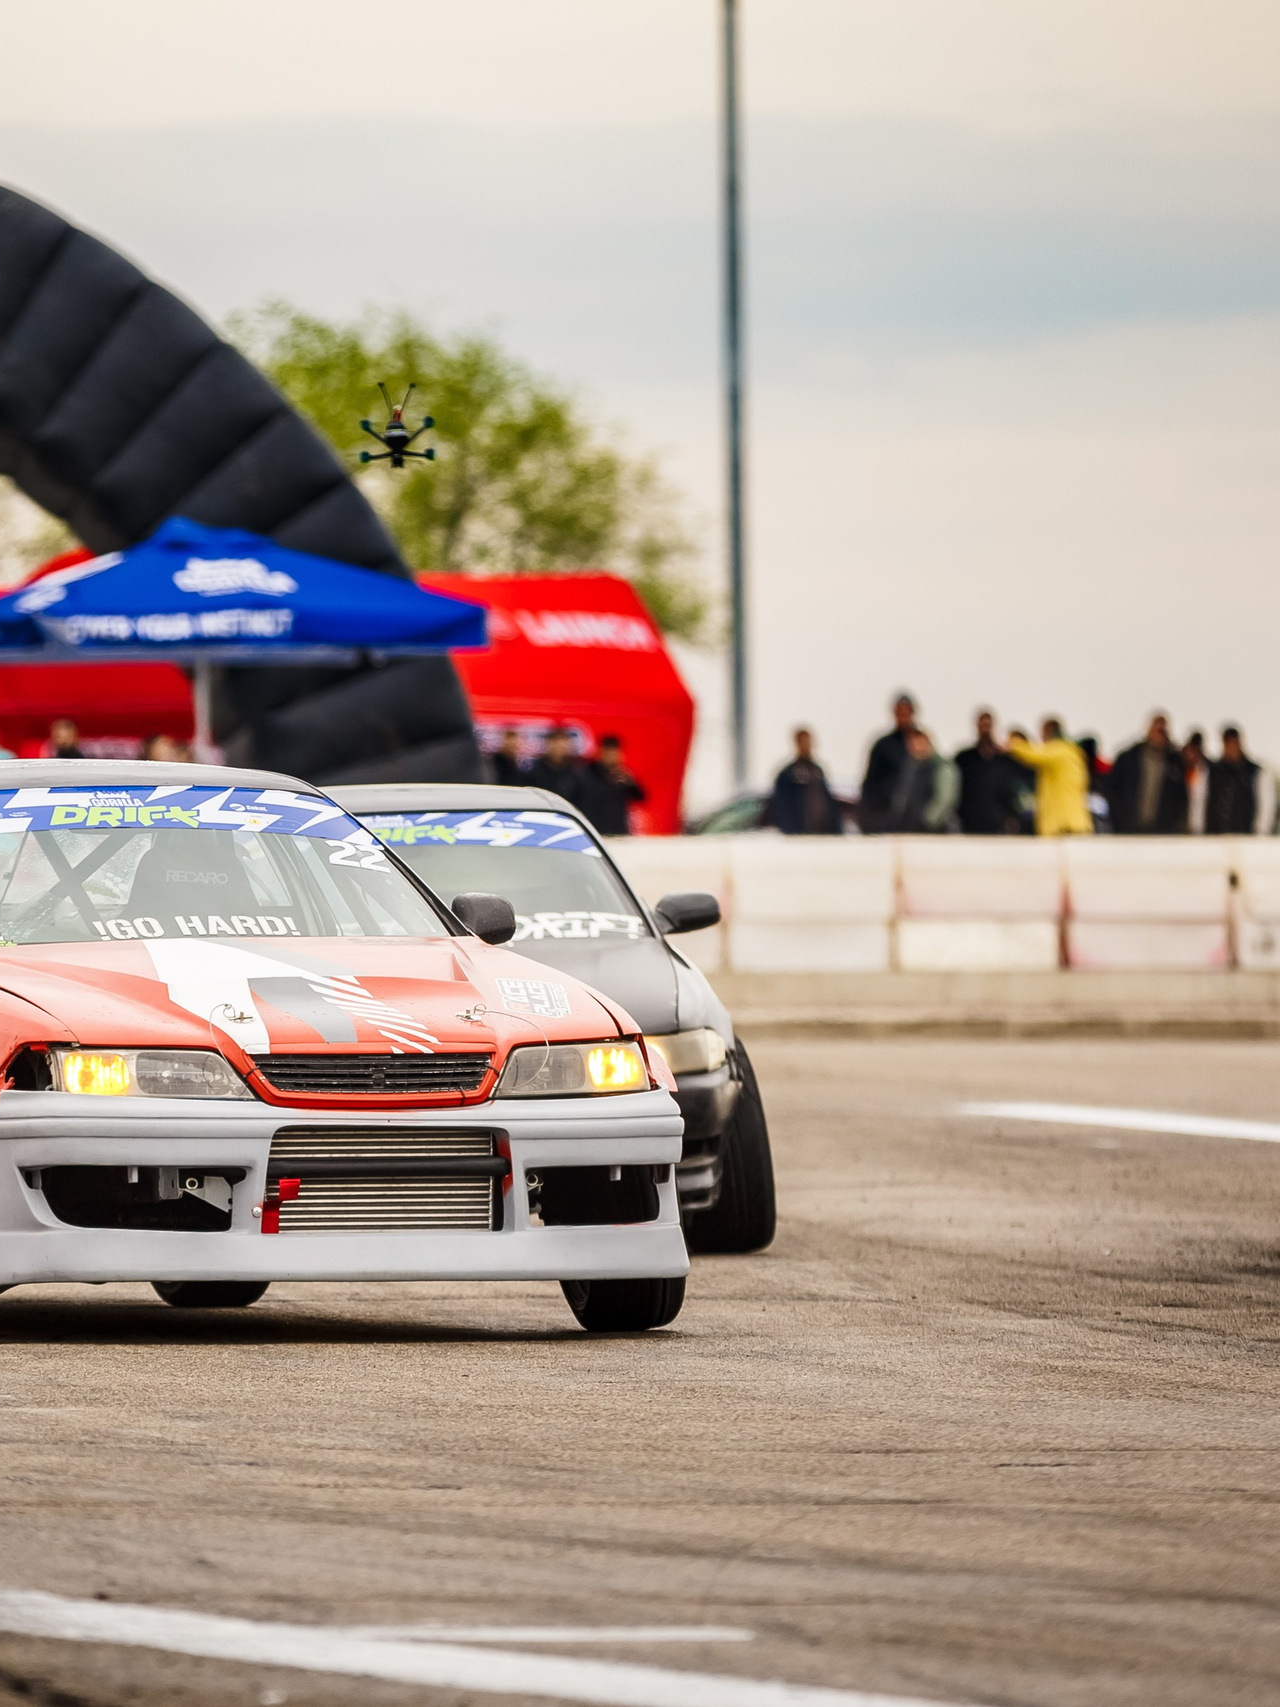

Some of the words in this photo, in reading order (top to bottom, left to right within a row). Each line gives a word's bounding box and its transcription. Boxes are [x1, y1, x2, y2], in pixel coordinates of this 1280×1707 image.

[89, 796, 145, 807] GORILLA
[50, 806, 201, 828] DRIFT
[370, 824, 460, 845] RIFT
[324, 839, 391, 874] 22
[166, 869, 229, 885] RECARO
[174, 915, 301, 936] HARD!
